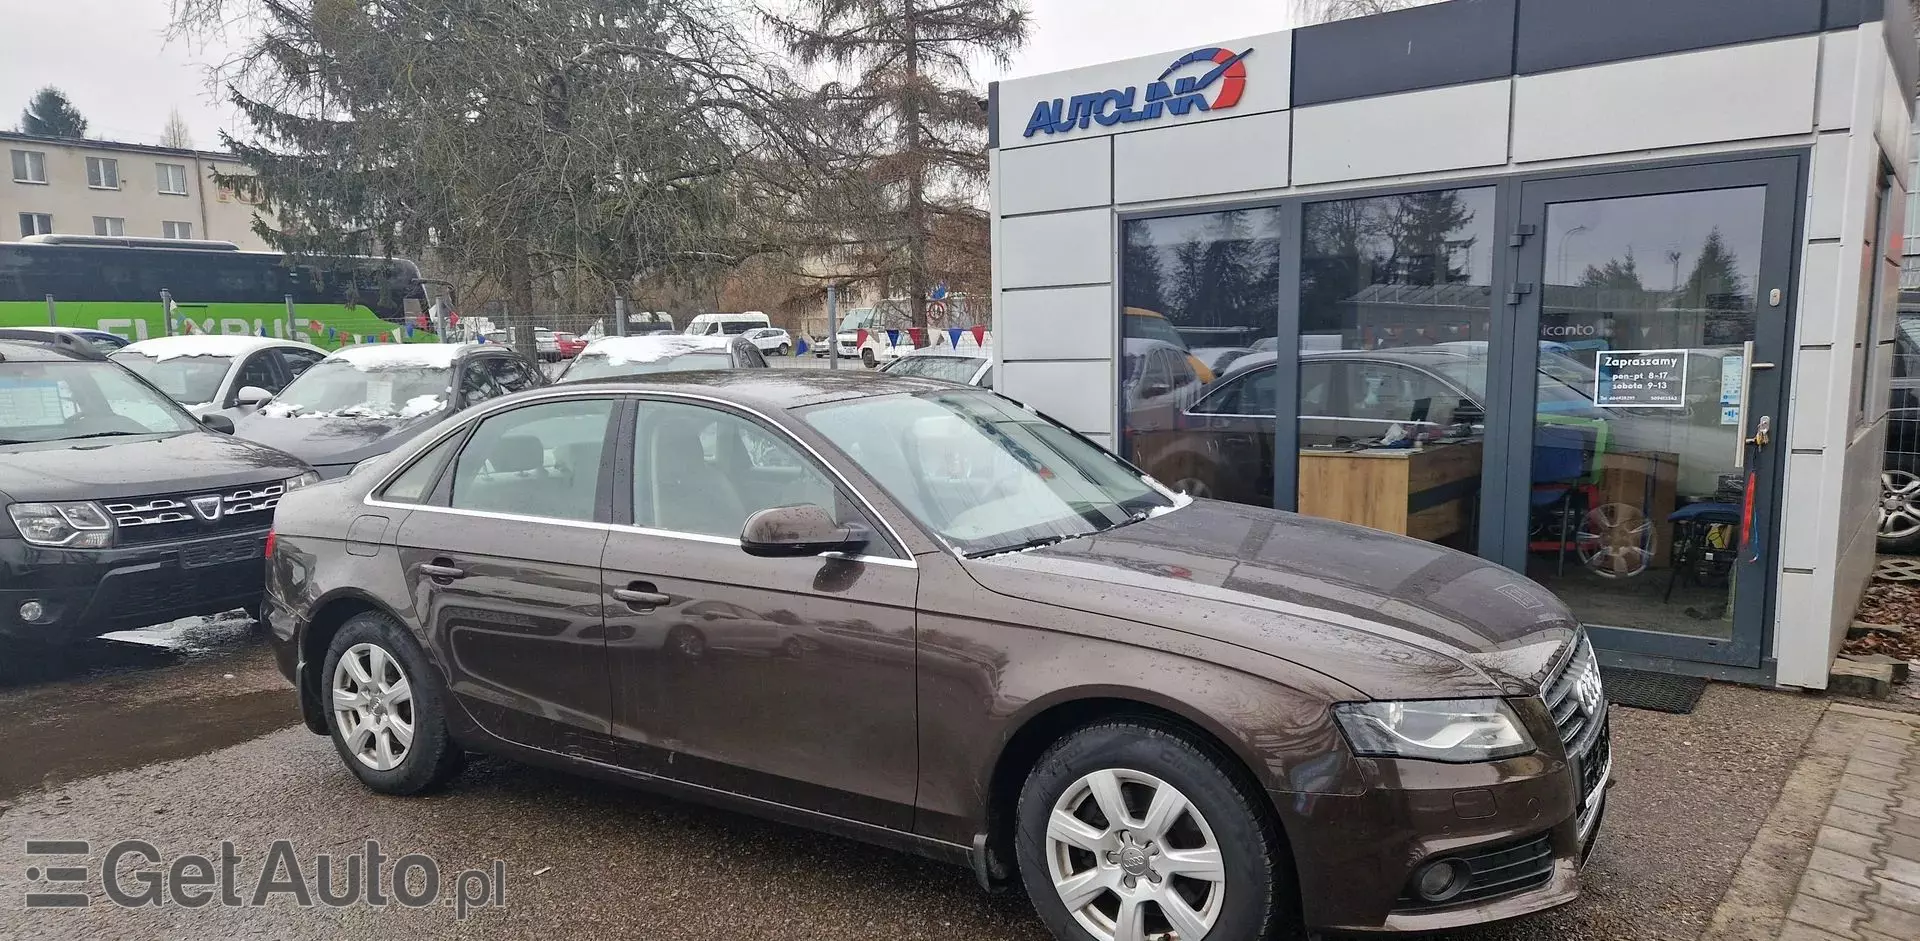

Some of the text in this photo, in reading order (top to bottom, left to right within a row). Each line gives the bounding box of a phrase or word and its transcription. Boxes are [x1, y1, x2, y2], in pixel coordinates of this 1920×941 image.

[1023, 76, 1211, 137] AUTOLINK
[1605, 356, 1677, 368] Zapraszamy
[1648, 371, 1668, 379] 8-17
[1612, 381, 1667, 390] sobota 9-13
